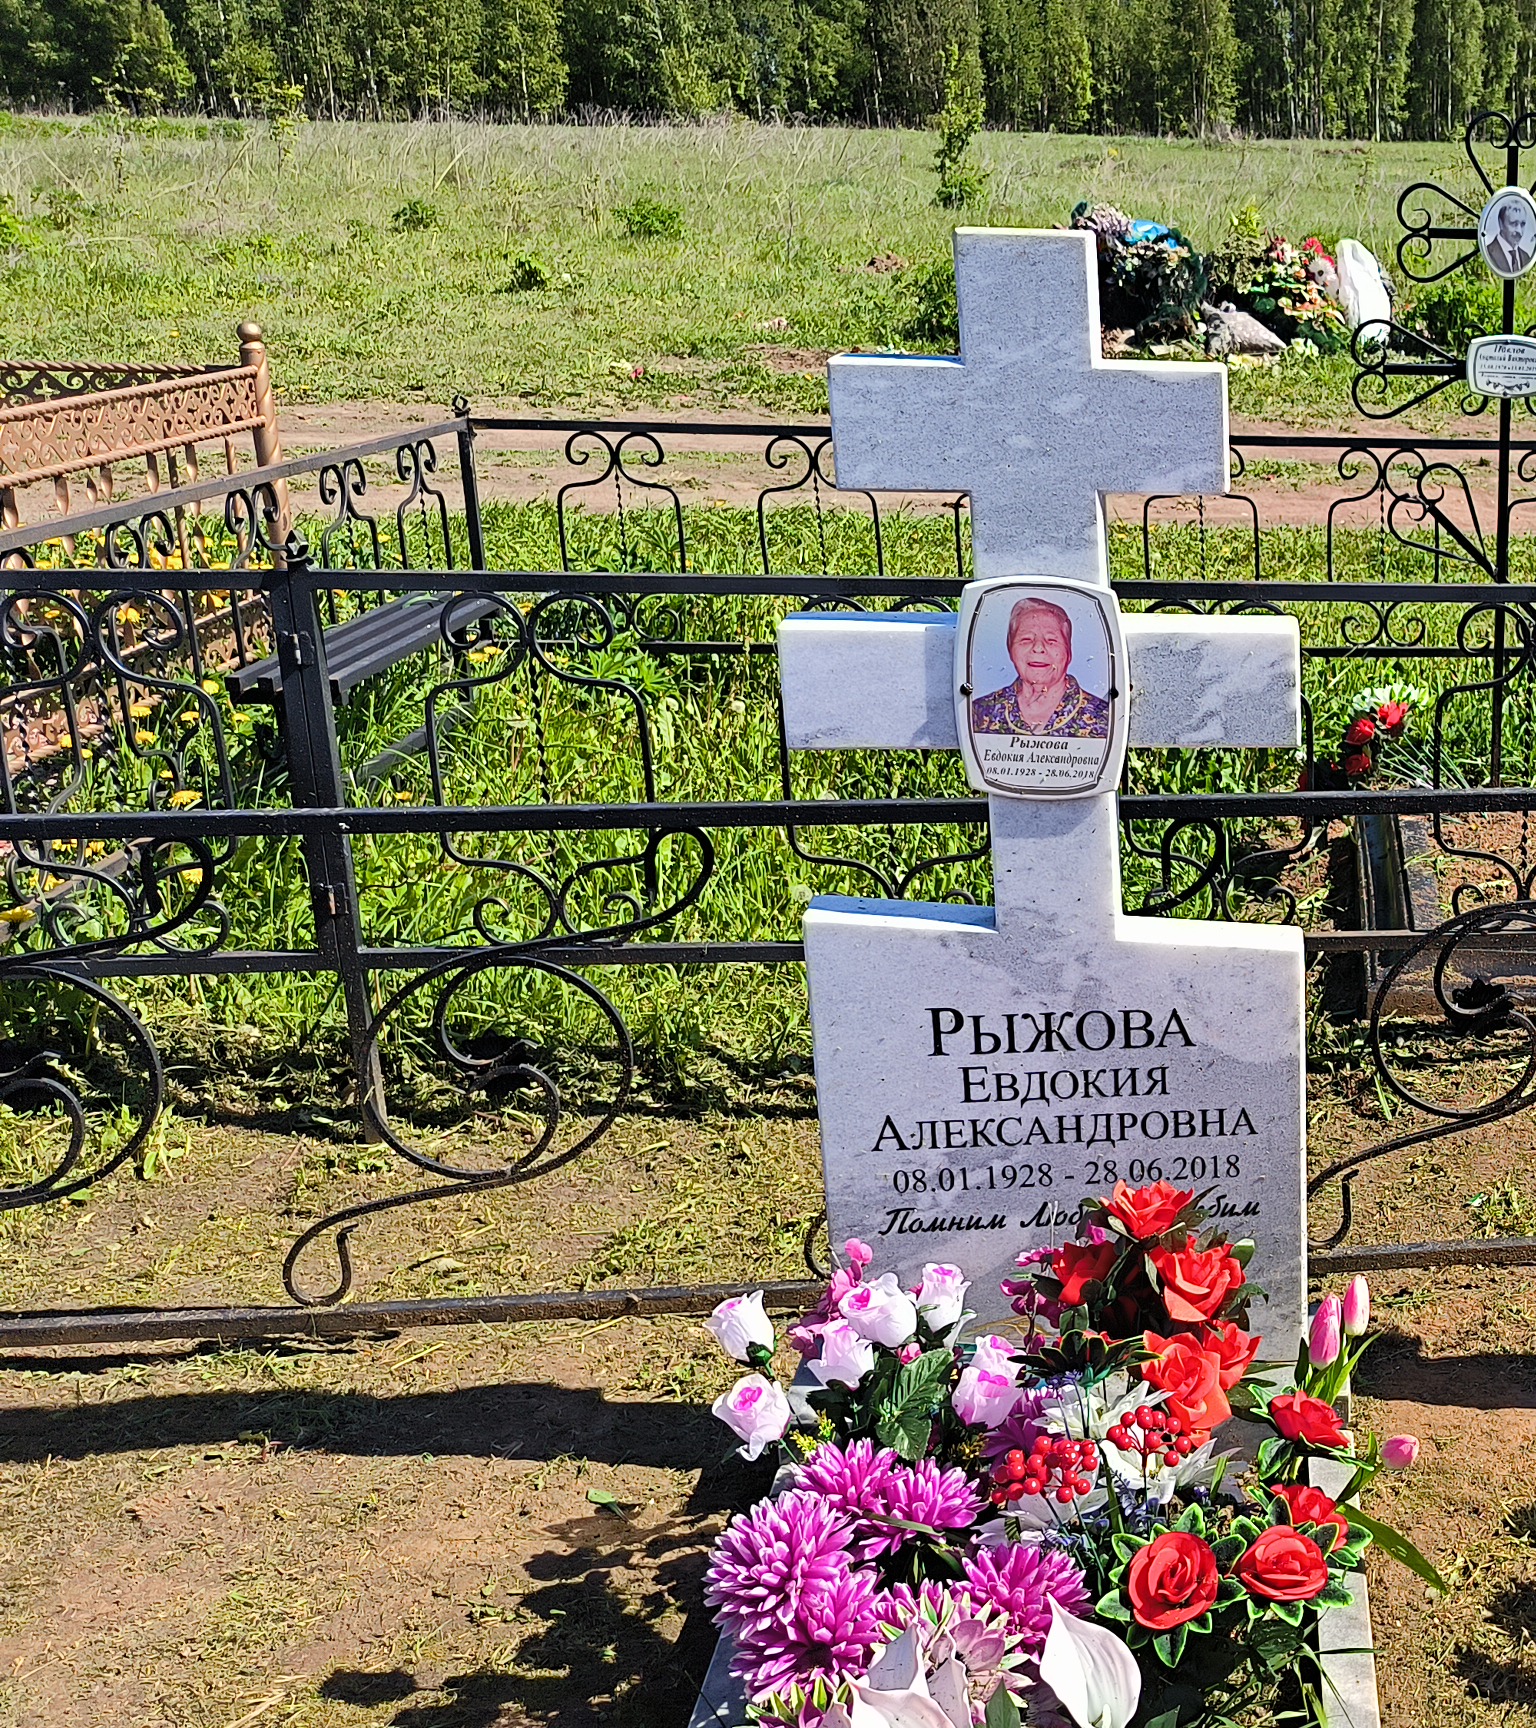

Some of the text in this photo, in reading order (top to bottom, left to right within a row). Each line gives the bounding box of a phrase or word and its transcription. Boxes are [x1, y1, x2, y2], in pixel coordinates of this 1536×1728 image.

[984, 749, 1099, 767] Евдокия Александровна
[1010, 736, 1068, 750] Рыжова
[987, 767, 1036, 777] 08.01.1928
[1045, 769, 1094, 779] 28.06.2018
[925, 1007, 1197, 1057] РЫЖОВА
[958, 1065, 1170, 1108] ЕВДОКИЯ
[872, 1107, 1258, 1153] АЛЕКСАНДРОВНА
[893, 1162, 1053, 1194] 08.01.1928
[1085, 1154, 1241, 1186] 28.06.2018
[879, 1200, 1088, 1236] Помним Люб
